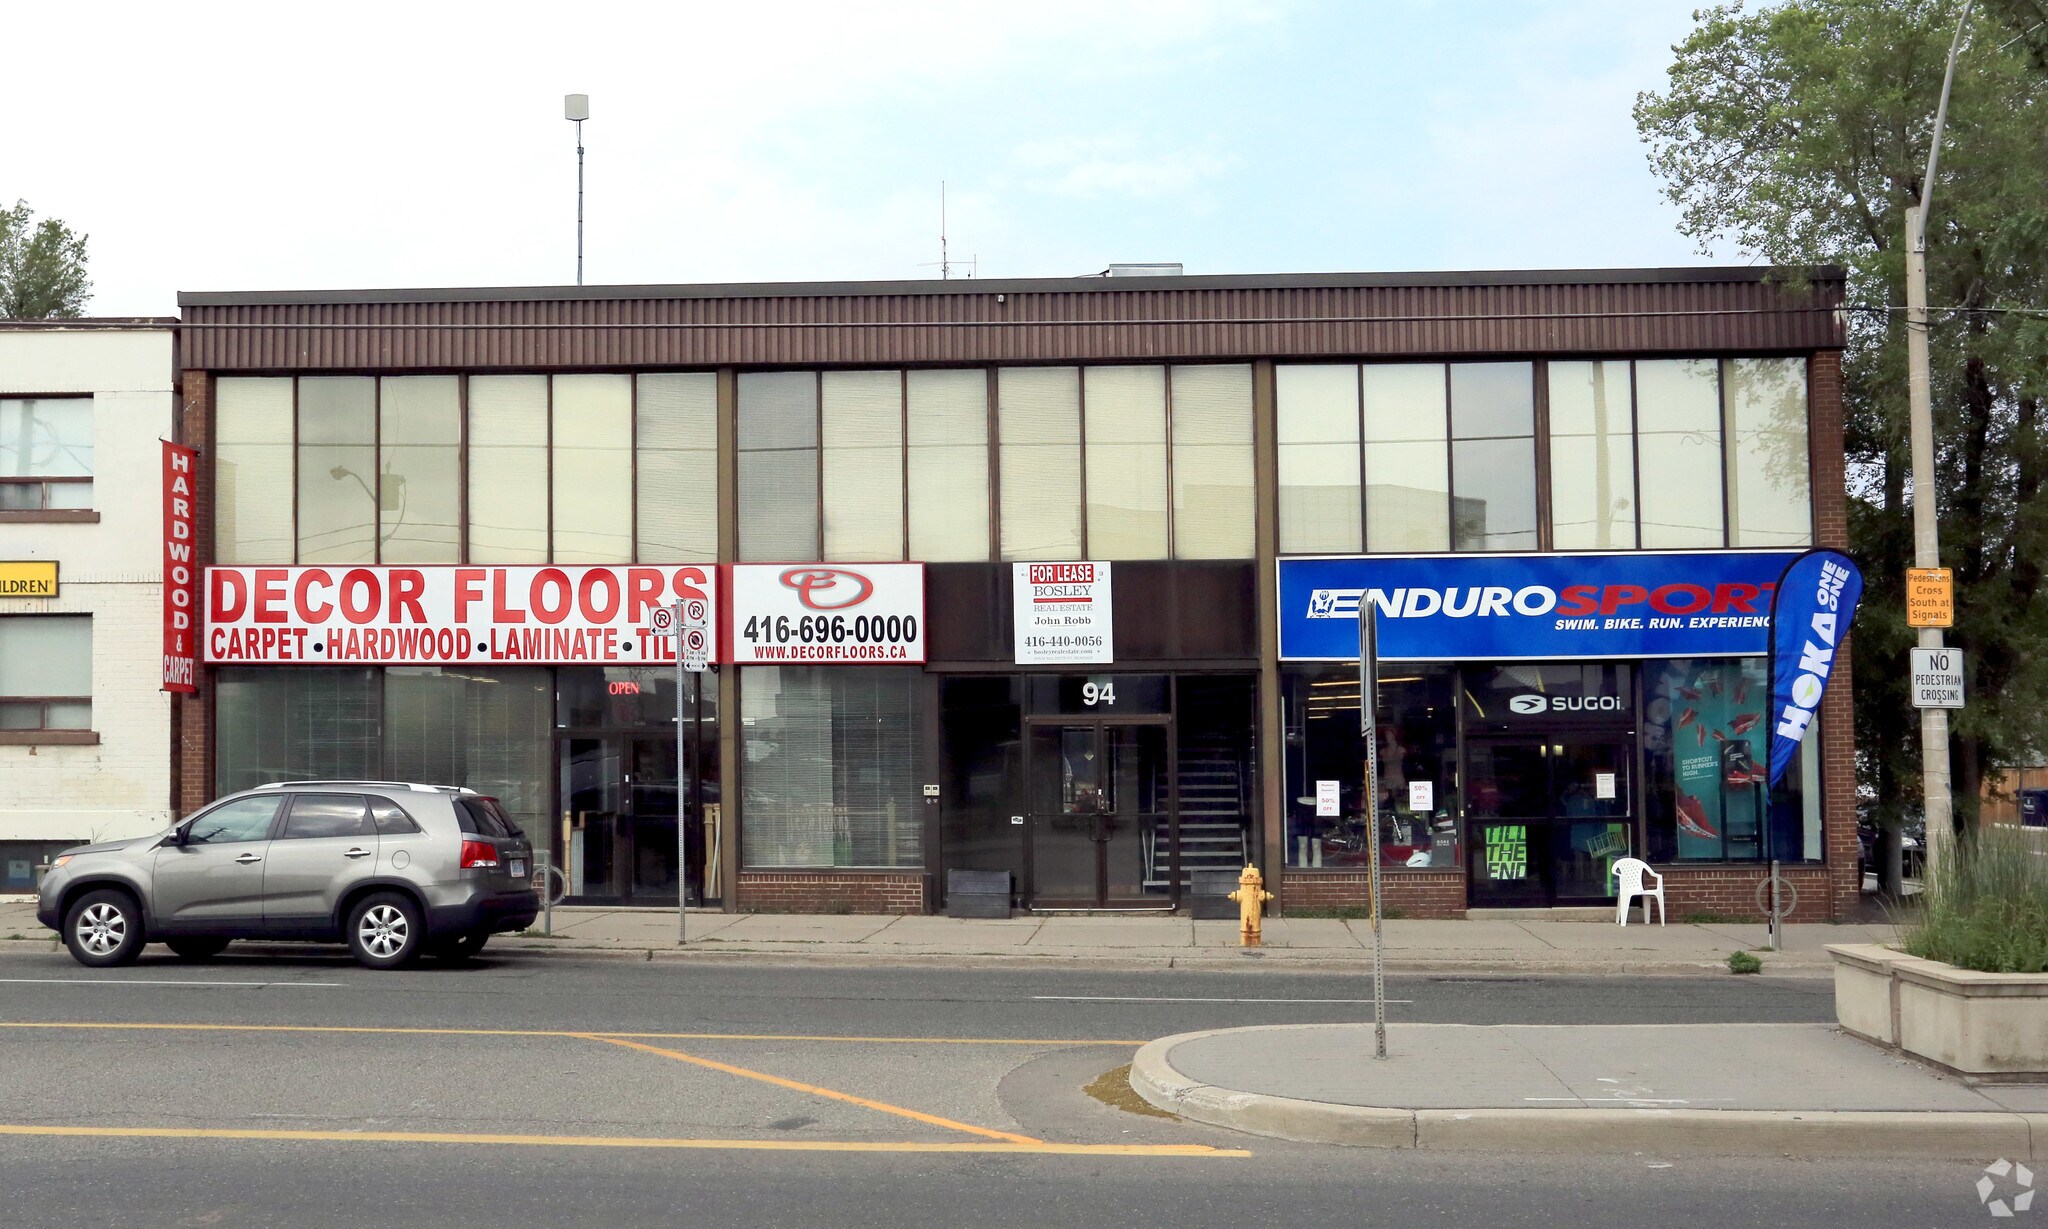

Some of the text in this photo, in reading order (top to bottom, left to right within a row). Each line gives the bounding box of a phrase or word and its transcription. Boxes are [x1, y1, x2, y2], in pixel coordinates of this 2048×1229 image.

[168, 452, 190, 652] HARDWOOD &
[1031, 565, 1053, 582] FOR
[1057, 564, 1092, 582] LEASE
[1909, 573, 1950, 583] Pedestrians
[0, 580, 49, 593] ILDREN
[1816, 559, 1838, 606] ONE
[1828, 566, 1851, 612] ONE
[211, 567, 708, 625] DECOR FLOORS
[1033, 585, 1092, 597] BOSLEY
[1916, 586, 1943, 595] Cross
[1034, 604, 1093, 612] REAL ESTATE
[1910, 598, 1950, 607] South at
[1034, 616, 1091, 625] John Robb
[1912, 609, 1948, 621] Signals
[743, 614, 917, 643] 416-696-0000
[1554, 618, 1599, 630] SWIM.
[1603, 618, 1644, 630] BIKE.
[1648, 618, 1684, 630] RUN.
[211, 627, 685, 660] CARPET HARDWOOD LAMINATE TIL
[1025, 635, 1102, 647] 416-440-0056
[754, 645, 907, 659] WWW.DECORFLOORS.CA
[164, 654, 193, 685] CARPET
[1929, 655, 1949, 671] NO
[1776, 612, 1837, 742] HOKA
[1915, 674, 1962, 686] PEDESTRIAN
[608, 681, 639, 695] OPEN
[1082, 682, 1116, 706] 94
[1921, 689, 1959, 701] CROSSING
[1682, 756, 1713, 765] SHORTCUT
[1486, 843, 1526, 861] THE
[1487, 862, 1527, 880] END
